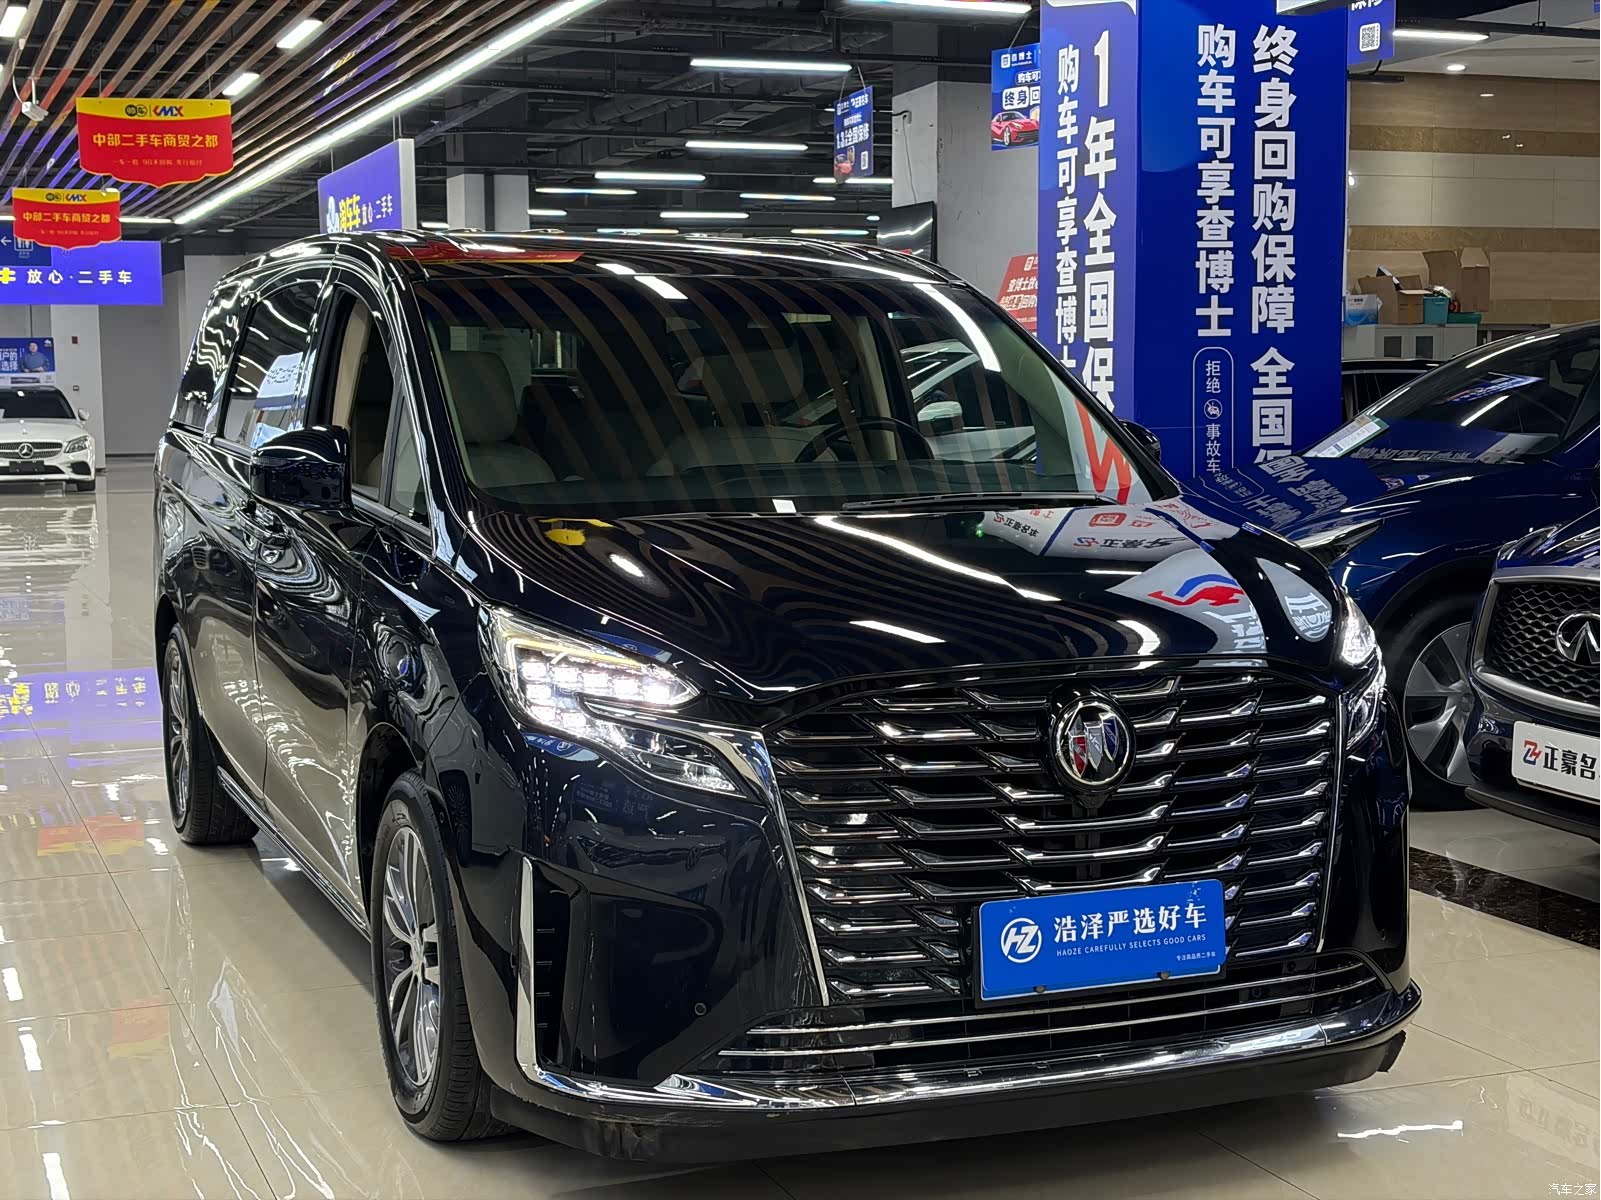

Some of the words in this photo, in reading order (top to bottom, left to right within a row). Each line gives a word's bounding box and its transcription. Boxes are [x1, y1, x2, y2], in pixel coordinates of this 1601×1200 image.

[1017, 70, 1041, 83] 购车可
[92, 133, 219, 148] 中部二手车商贸之都
[1195, 24, 1236, 337] 购车可享查博士
[1250, 24, 1299, 335] 终身回购保障
[22, 211, 111, 224] 中部二手车商贸之都
[1205, 359, 1221, 394] 拒绝
[1543, 744, 1600, 781] 正豪名
[1053, 902, 1208, 944] 浩泽严选好车
[1056, 947, 1082, 957] HAOZE
[1084, 942, 1127, 954] CAREFULLY
[1129, 938, 1161, 949] SELECTS
[1163, 936, 1185, 945] GOOD
[1187, 933, 1207, 943] CARS
